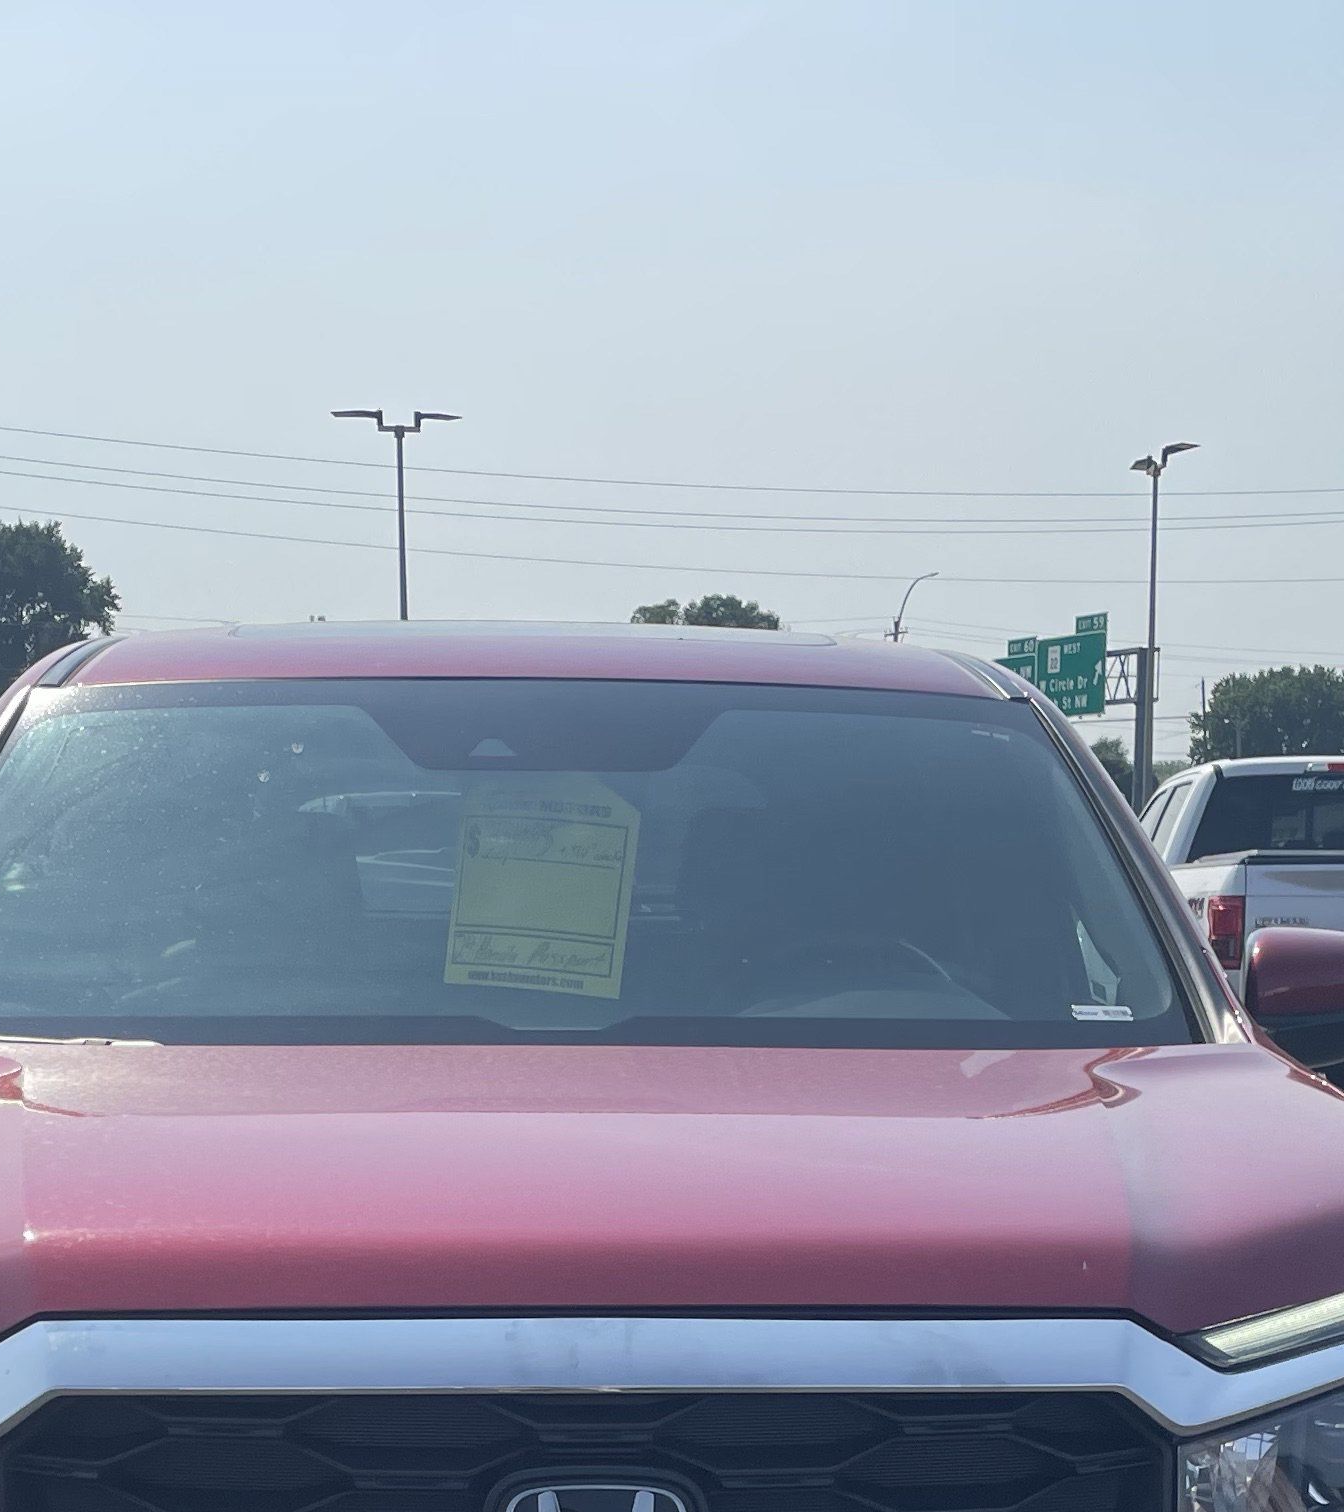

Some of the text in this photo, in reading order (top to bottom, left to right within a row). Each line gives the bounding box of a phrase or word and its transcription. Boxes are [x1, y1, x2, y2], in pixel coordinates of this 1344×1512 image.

[1093, 616, 1105, 629] 59
[1063, 642, 1081, 655] WEST
[1049, 677, 1074, 693] Circle
[1077, 675, 1088, 690] Dr
[1061, 696, 1072, 710] St
[1074, 694, 1088, 708] NW
